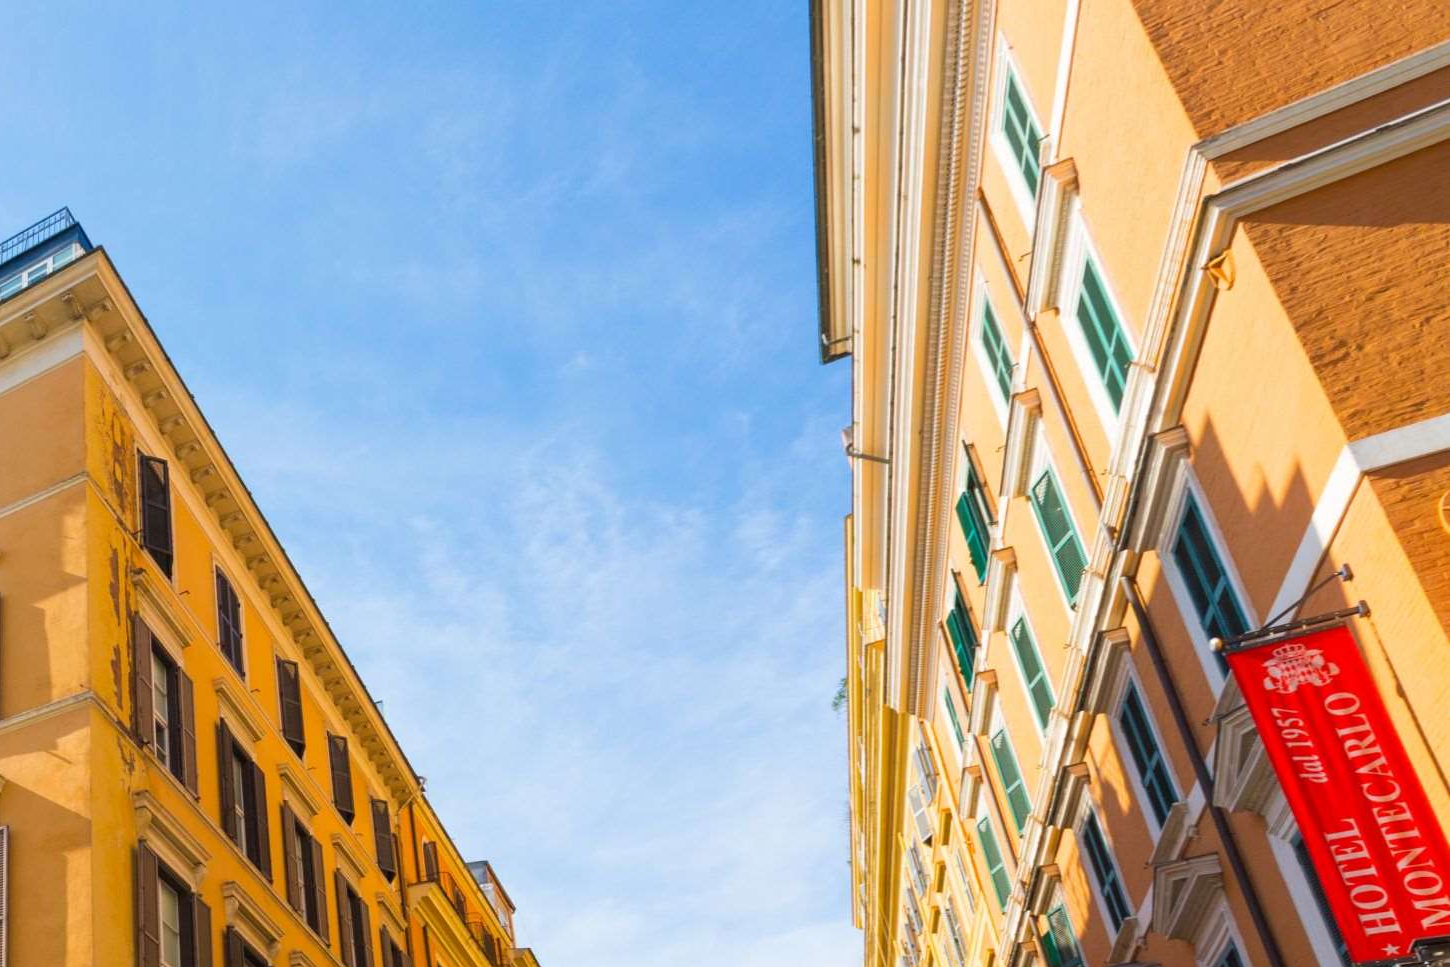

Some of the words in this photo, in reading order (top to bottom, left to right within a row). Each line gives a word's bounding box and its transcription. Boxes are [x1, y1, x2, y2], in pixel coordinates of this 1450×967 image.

[1270, 707, 1314, 749] 1957
[1293, 754, 1329, 784] dal
[1324, 691, 1450, 930] MONTECARLO
[1324, 818, 1403, 937] HOTEL
